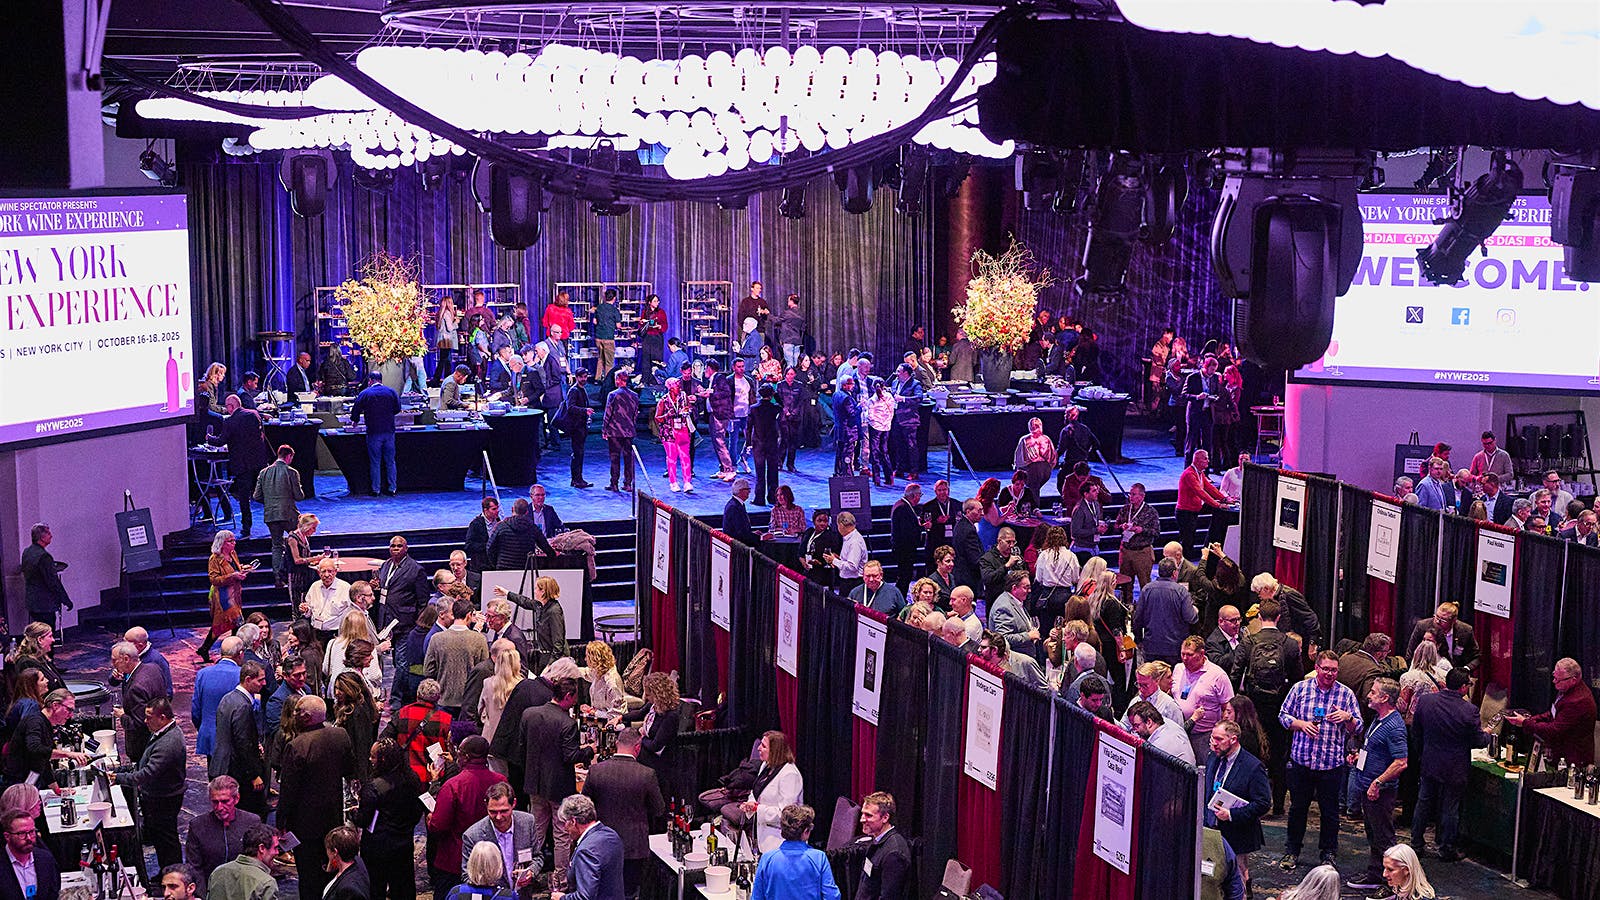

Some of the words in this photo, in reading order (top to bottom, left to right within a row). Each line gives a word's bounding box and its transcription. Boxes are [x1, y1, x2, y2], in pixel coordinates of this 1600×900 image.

[0, 202, 18, 211] WINE
[20, 201, 61, 211] SPECTATOR
[62, 200, 97, 209] PRESENTS
[1412, 197, 1434, 205] WINE
[26, 212, 62, 232] WINE
[66, 210, 144, 231] EXPERIENCE
[1358, 206, 1391, 220] NEW
[1395, 206, 1437, 221] YORK
[50, 244, 127, 282] YORK
[8, 283, 179, 331] EXPERIENCE
[16, 346, 37, 357] NEW
[39, 343, 63, 354] YORK
[64, 340, 84, 352] CITY
[97, 335, 136, 349] OCTOBER
[161, 331, 180, 342] 2025
[1434, 371, 1490, 382] #NYWE2025
[35, 417, 84, 433] #NYWE2025
